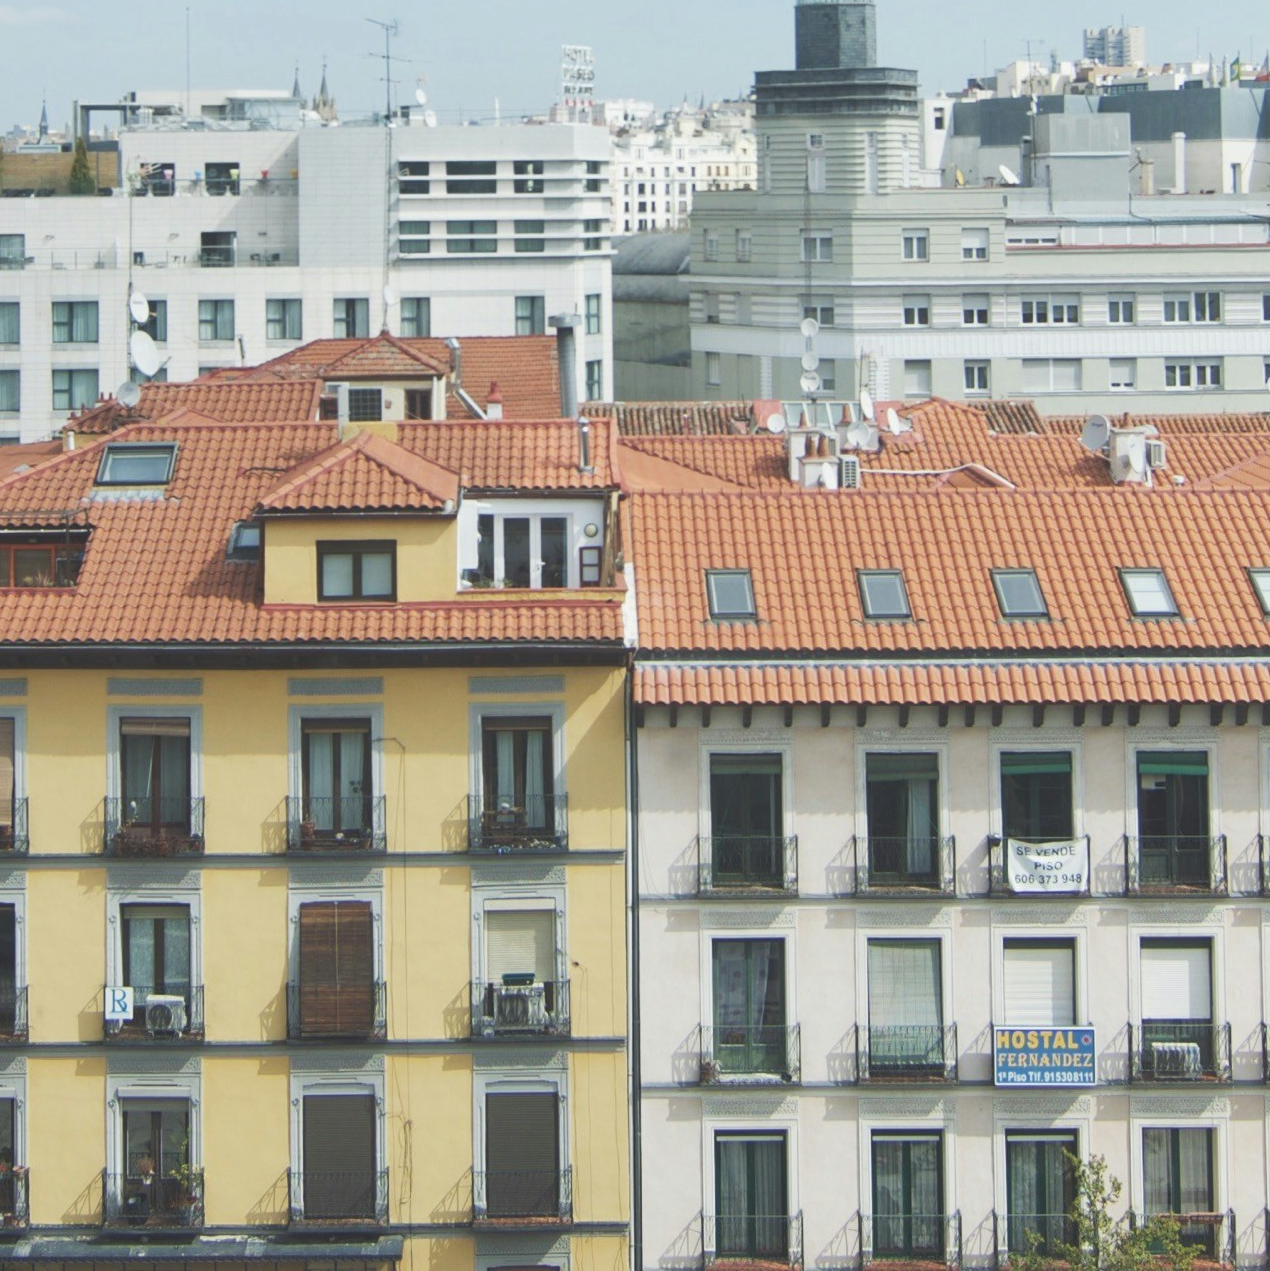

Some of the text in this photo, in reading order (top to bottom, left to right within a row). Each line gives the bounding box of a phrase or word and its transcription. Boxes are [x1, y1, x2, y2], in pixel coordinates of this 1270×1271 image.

[1016, 846, 1076, 857] SE VENDE
[1034, 861, 1063, 870] PISO
[1015, 873, 1082, 884] 606 373 948
[996, 1031, 1079, 1049] HOSTAL
[998, 1052, 1093, 1068] FERNANDEZ
[1008, 1071, 1027, 1082] Piso
